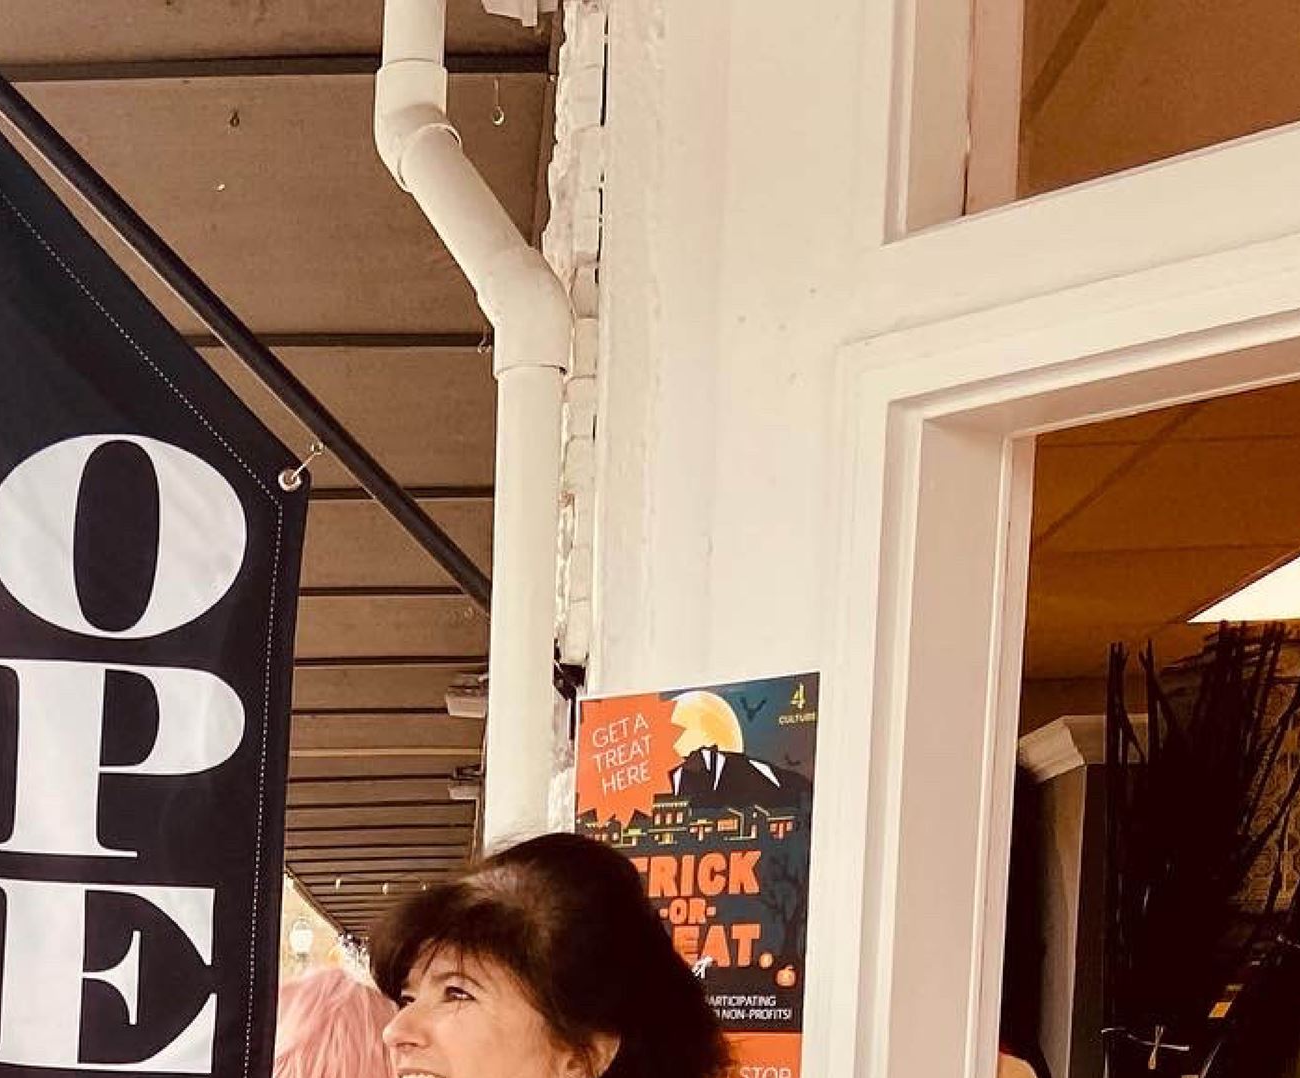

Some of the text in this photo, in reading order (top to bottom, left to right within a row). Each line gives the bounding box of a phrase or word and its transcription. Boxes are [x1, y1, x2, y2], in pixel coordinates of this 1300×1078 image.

[790, 683, 806, 709] 4
[592, 713, 649, 748] GET A
[592, 734, 651, 774] TREAT
[601, 760, 651, 796] HERE
[672, 923, 761, 968] EAT
[705, 994, 776, 1007] ARTICIPATING
[721, 1008, 792, 1020] NON-PROFITS!
